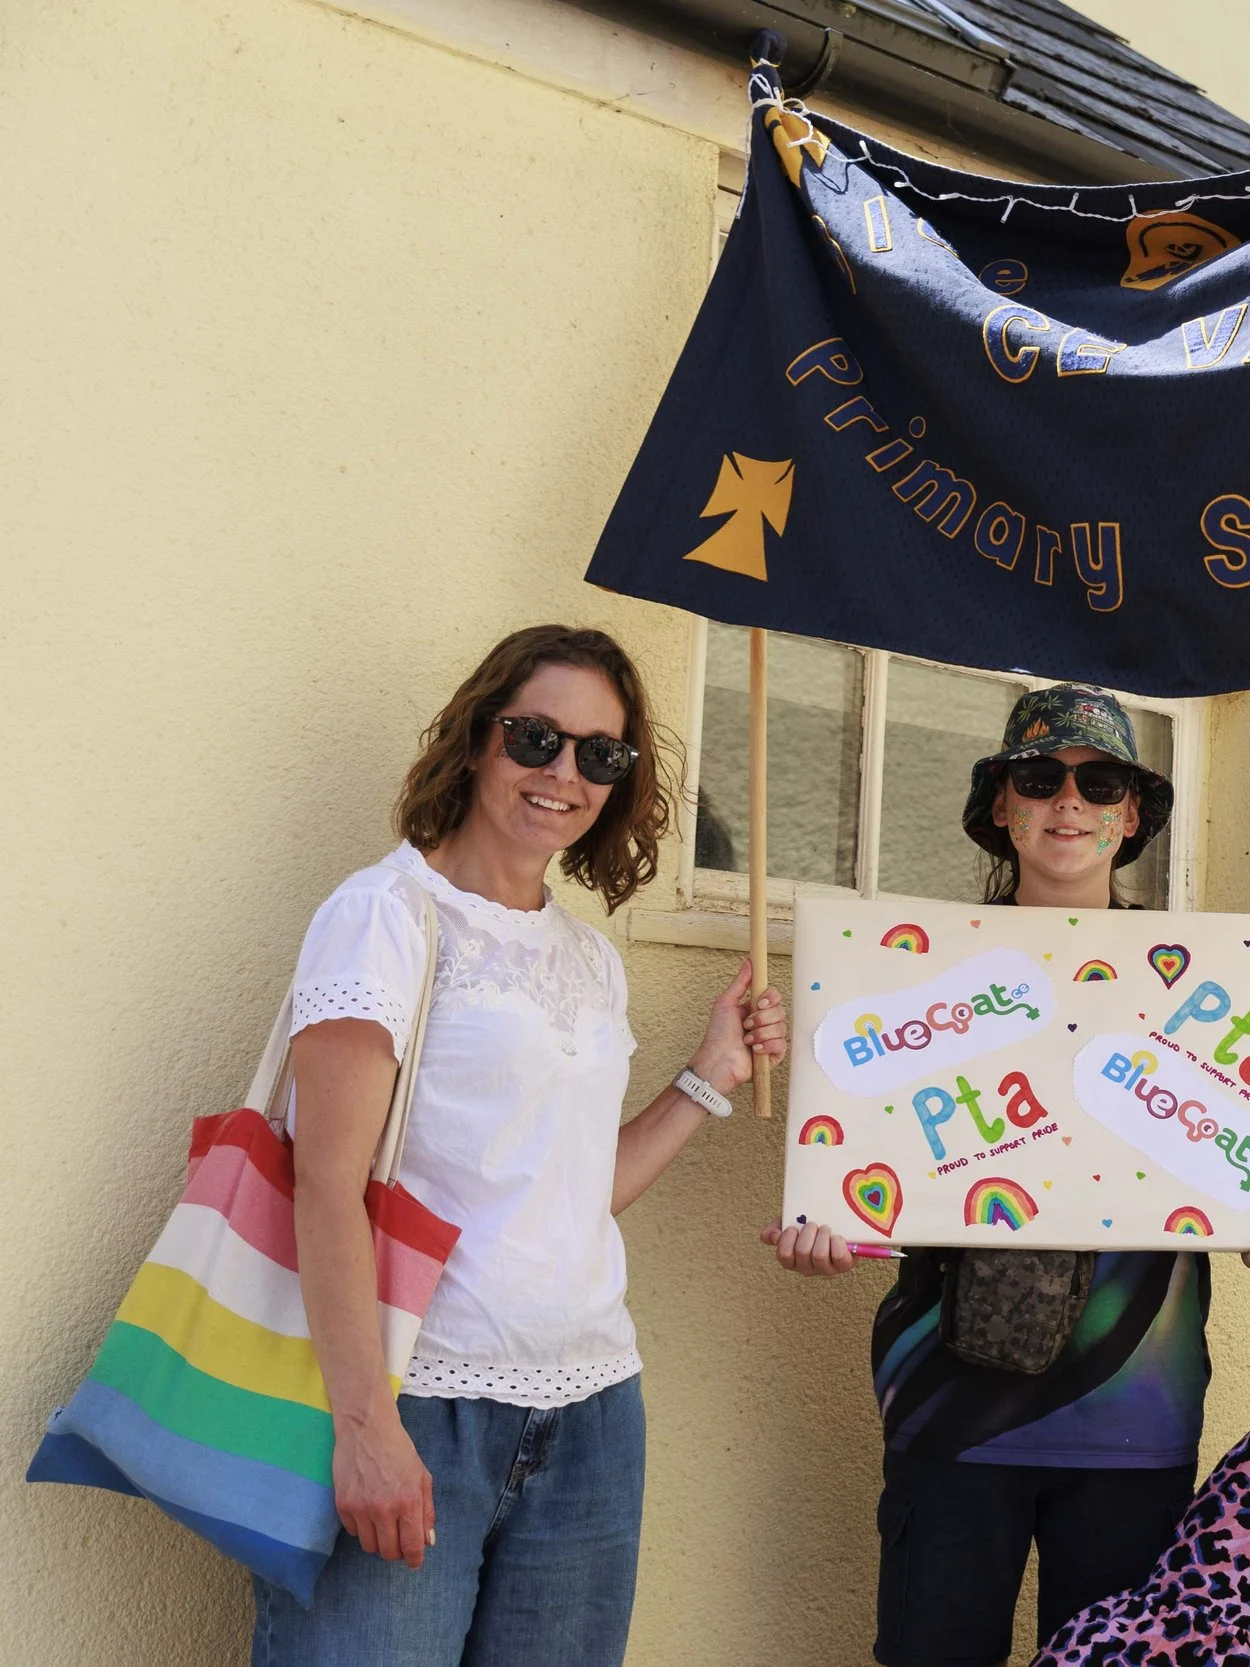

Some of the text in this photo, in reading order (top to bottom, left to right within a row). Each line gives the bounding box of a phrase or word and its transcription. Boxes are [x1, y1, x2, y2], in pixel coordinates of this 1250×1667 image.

[786, 337, 1124, 611] Primary
[1149, 1031, 1180, 1052] PROUD
[1186, 1051, 1198, 1062] TO
[1200, 1062, 1237, 1088] SUPPORT
[937, 1123, 1059, 1175] PROUD TO SUPPORT PRIDE
